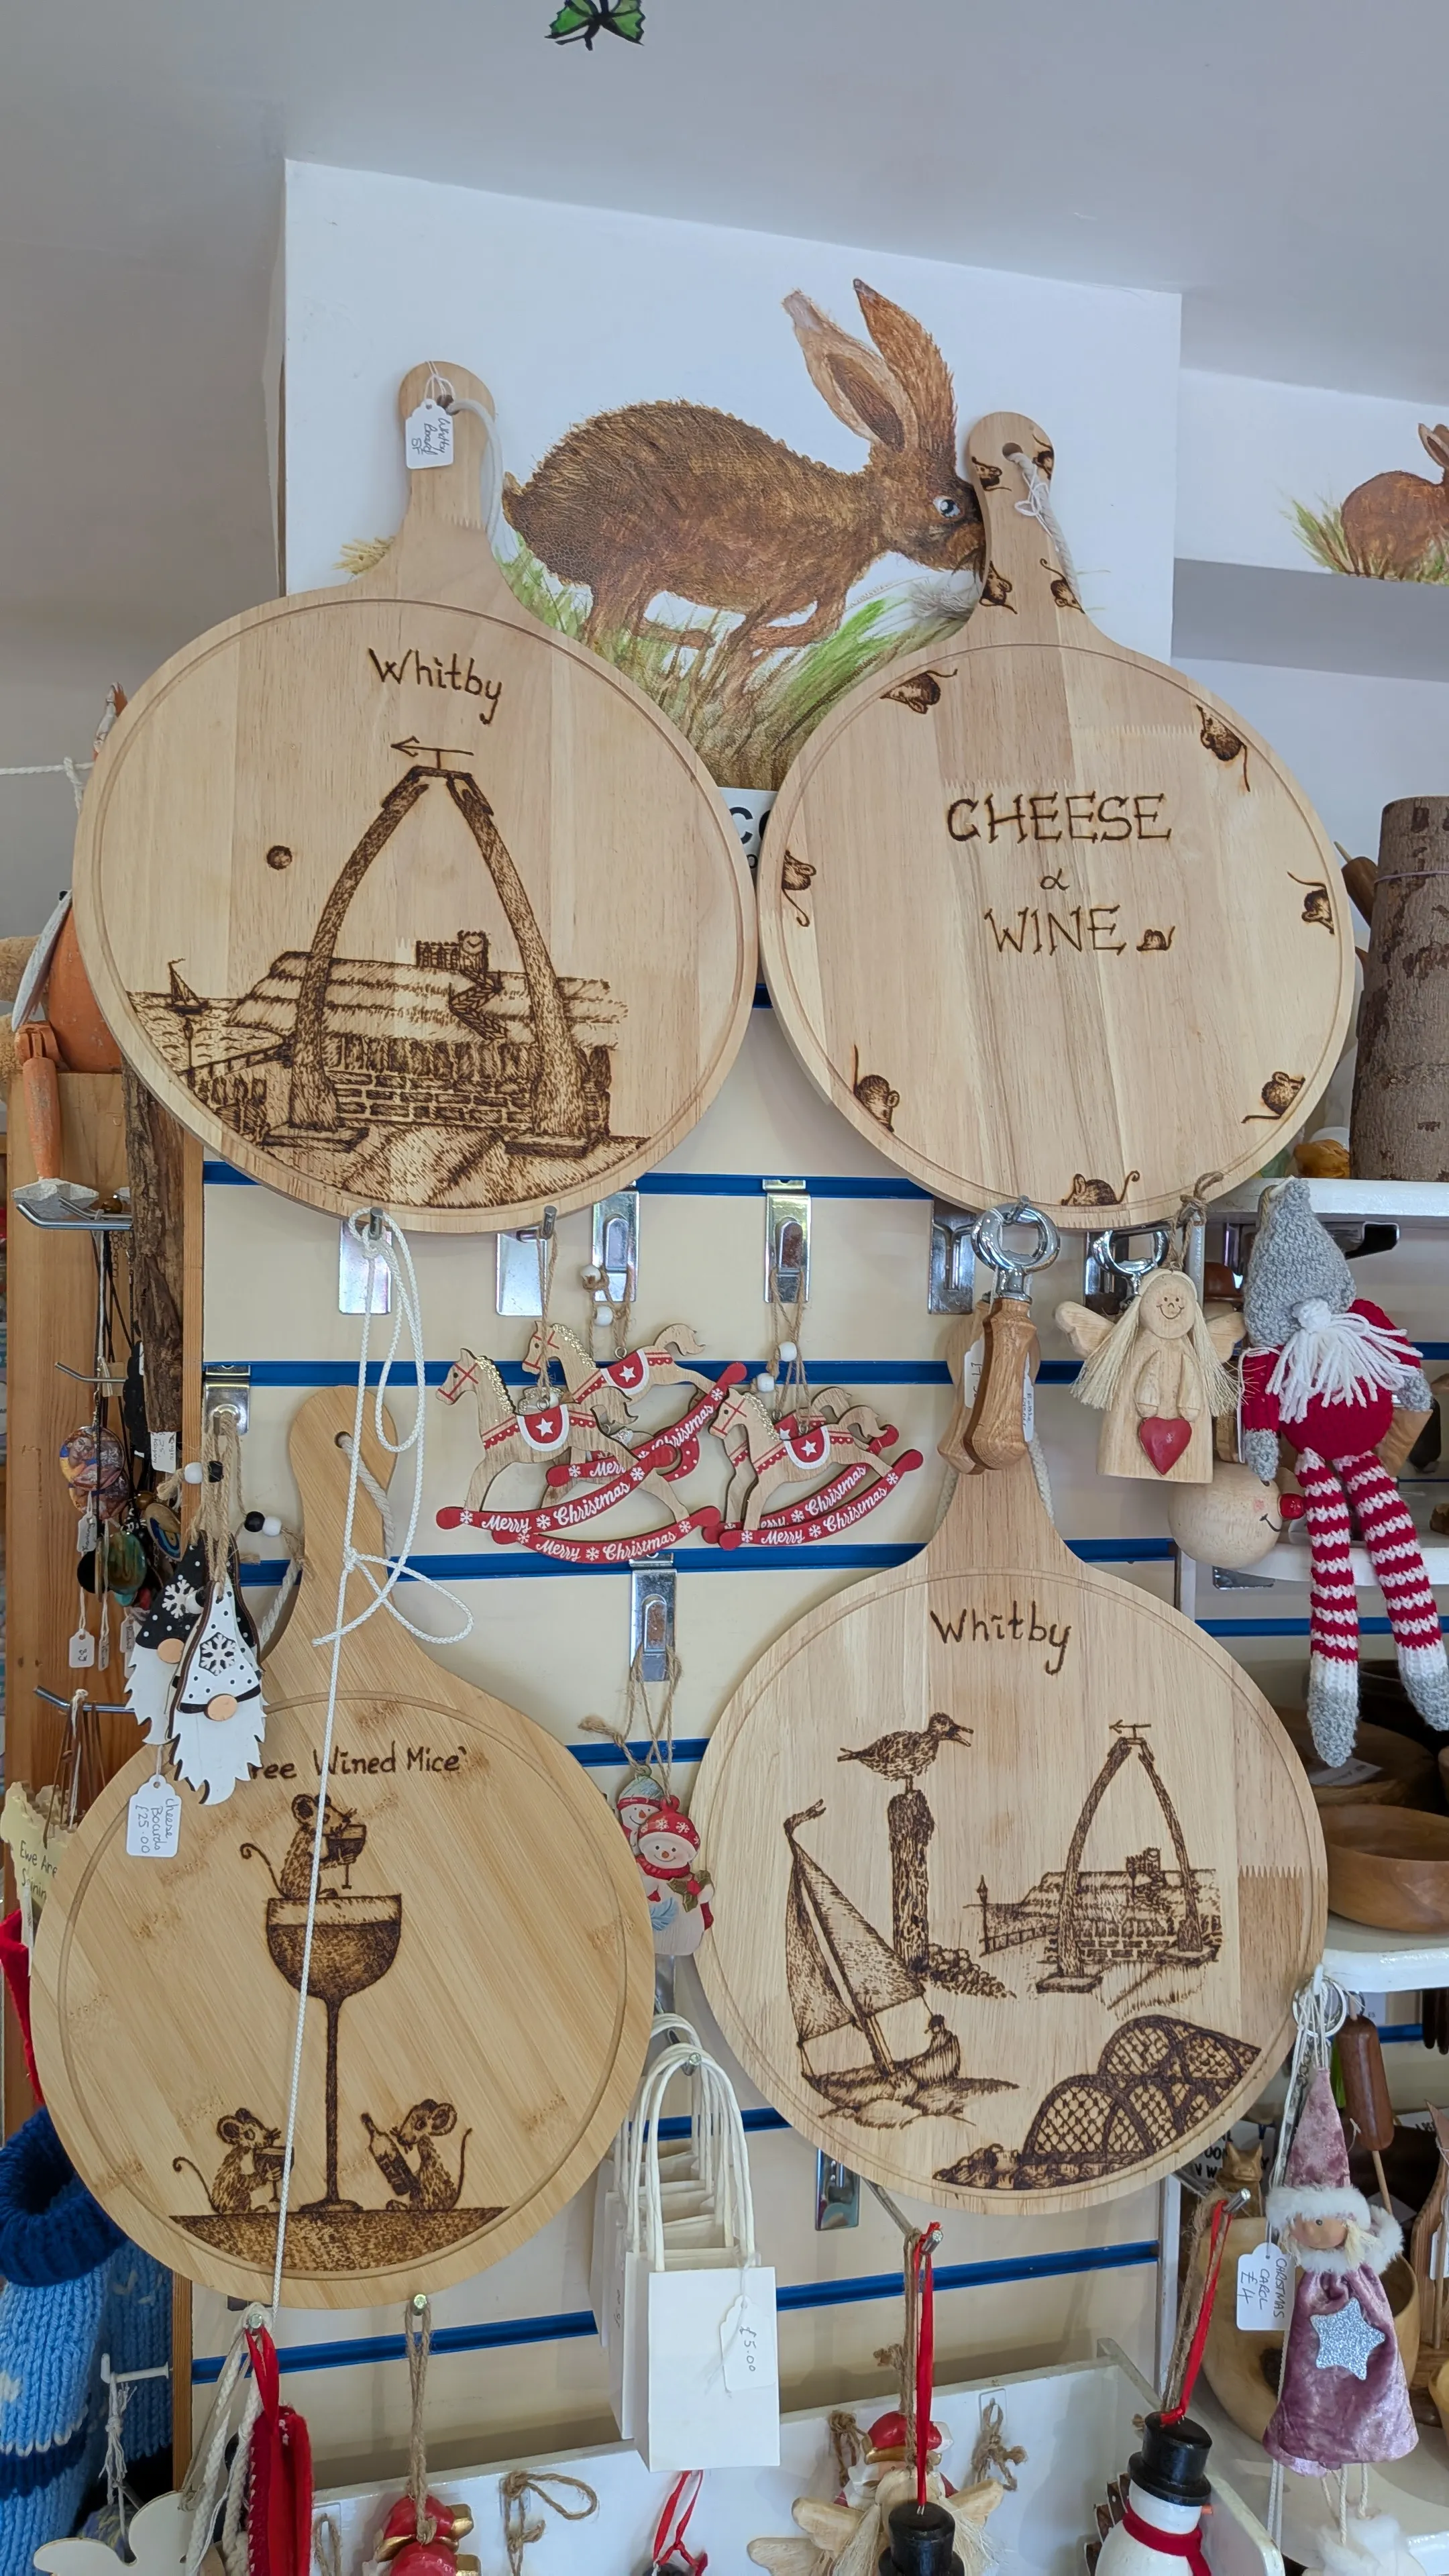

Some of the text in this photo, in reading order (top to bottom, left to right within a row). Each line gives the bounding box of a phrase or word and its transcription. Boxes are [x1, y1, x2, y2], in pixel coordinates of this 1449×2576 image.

[368, 648, 502, 724] Whitby
[947, 791, 1171, 844] CHEESE
[984, 905, 1127, 955] WINE
[590, 1460, 626, 1477] Merr
[806, 1464, 867, 1516] Christmas
[481, 1481, 631, 1534] Merry Christmas
[761, 1487, 888, 1545] Merry Christmas
[535, 1530, 678, 1562] Merry Christmas
[930, 1600, 1071, 1675] Whitby
[248, 1762, 297, 1780] ree
[313, 1740, 396, 1776] Wined
[20, 1840, 38, 1866] Ewe
[136, 1805, 150, 1854] £25.00
[1237, 2271, 1258, 2304] £4
[1258, 2268, 1271, 2311] CAROL
[1273, 2257, 1288, 2319] CHRISTMAS
[739, 2326, 757, 2372] £5.00
